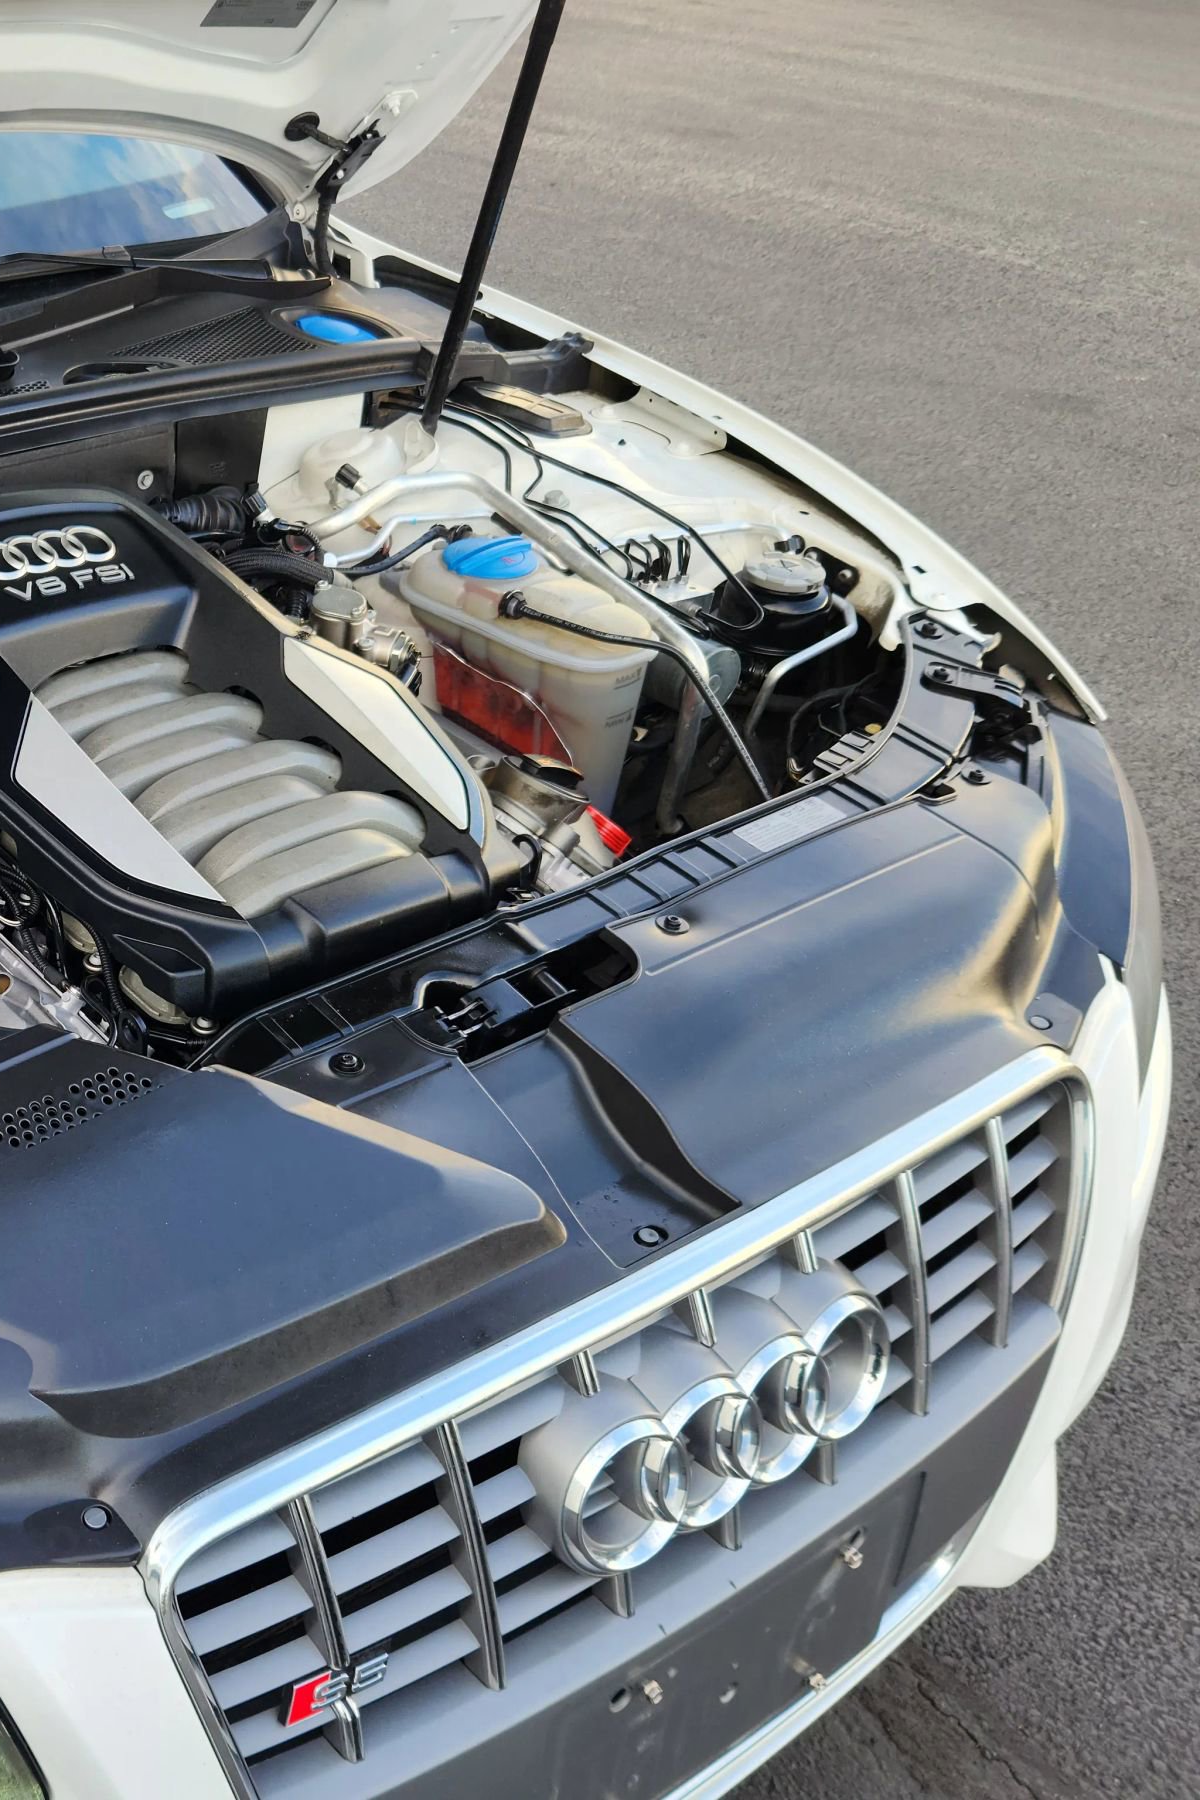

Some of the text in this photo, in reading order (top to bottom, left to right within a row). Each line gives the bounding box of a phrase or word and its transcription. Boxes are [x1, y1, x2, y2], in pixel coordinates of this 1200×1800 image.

[4, 563, 135, 601] V8 FSI
[311, 1653, 389, 1711] S5
